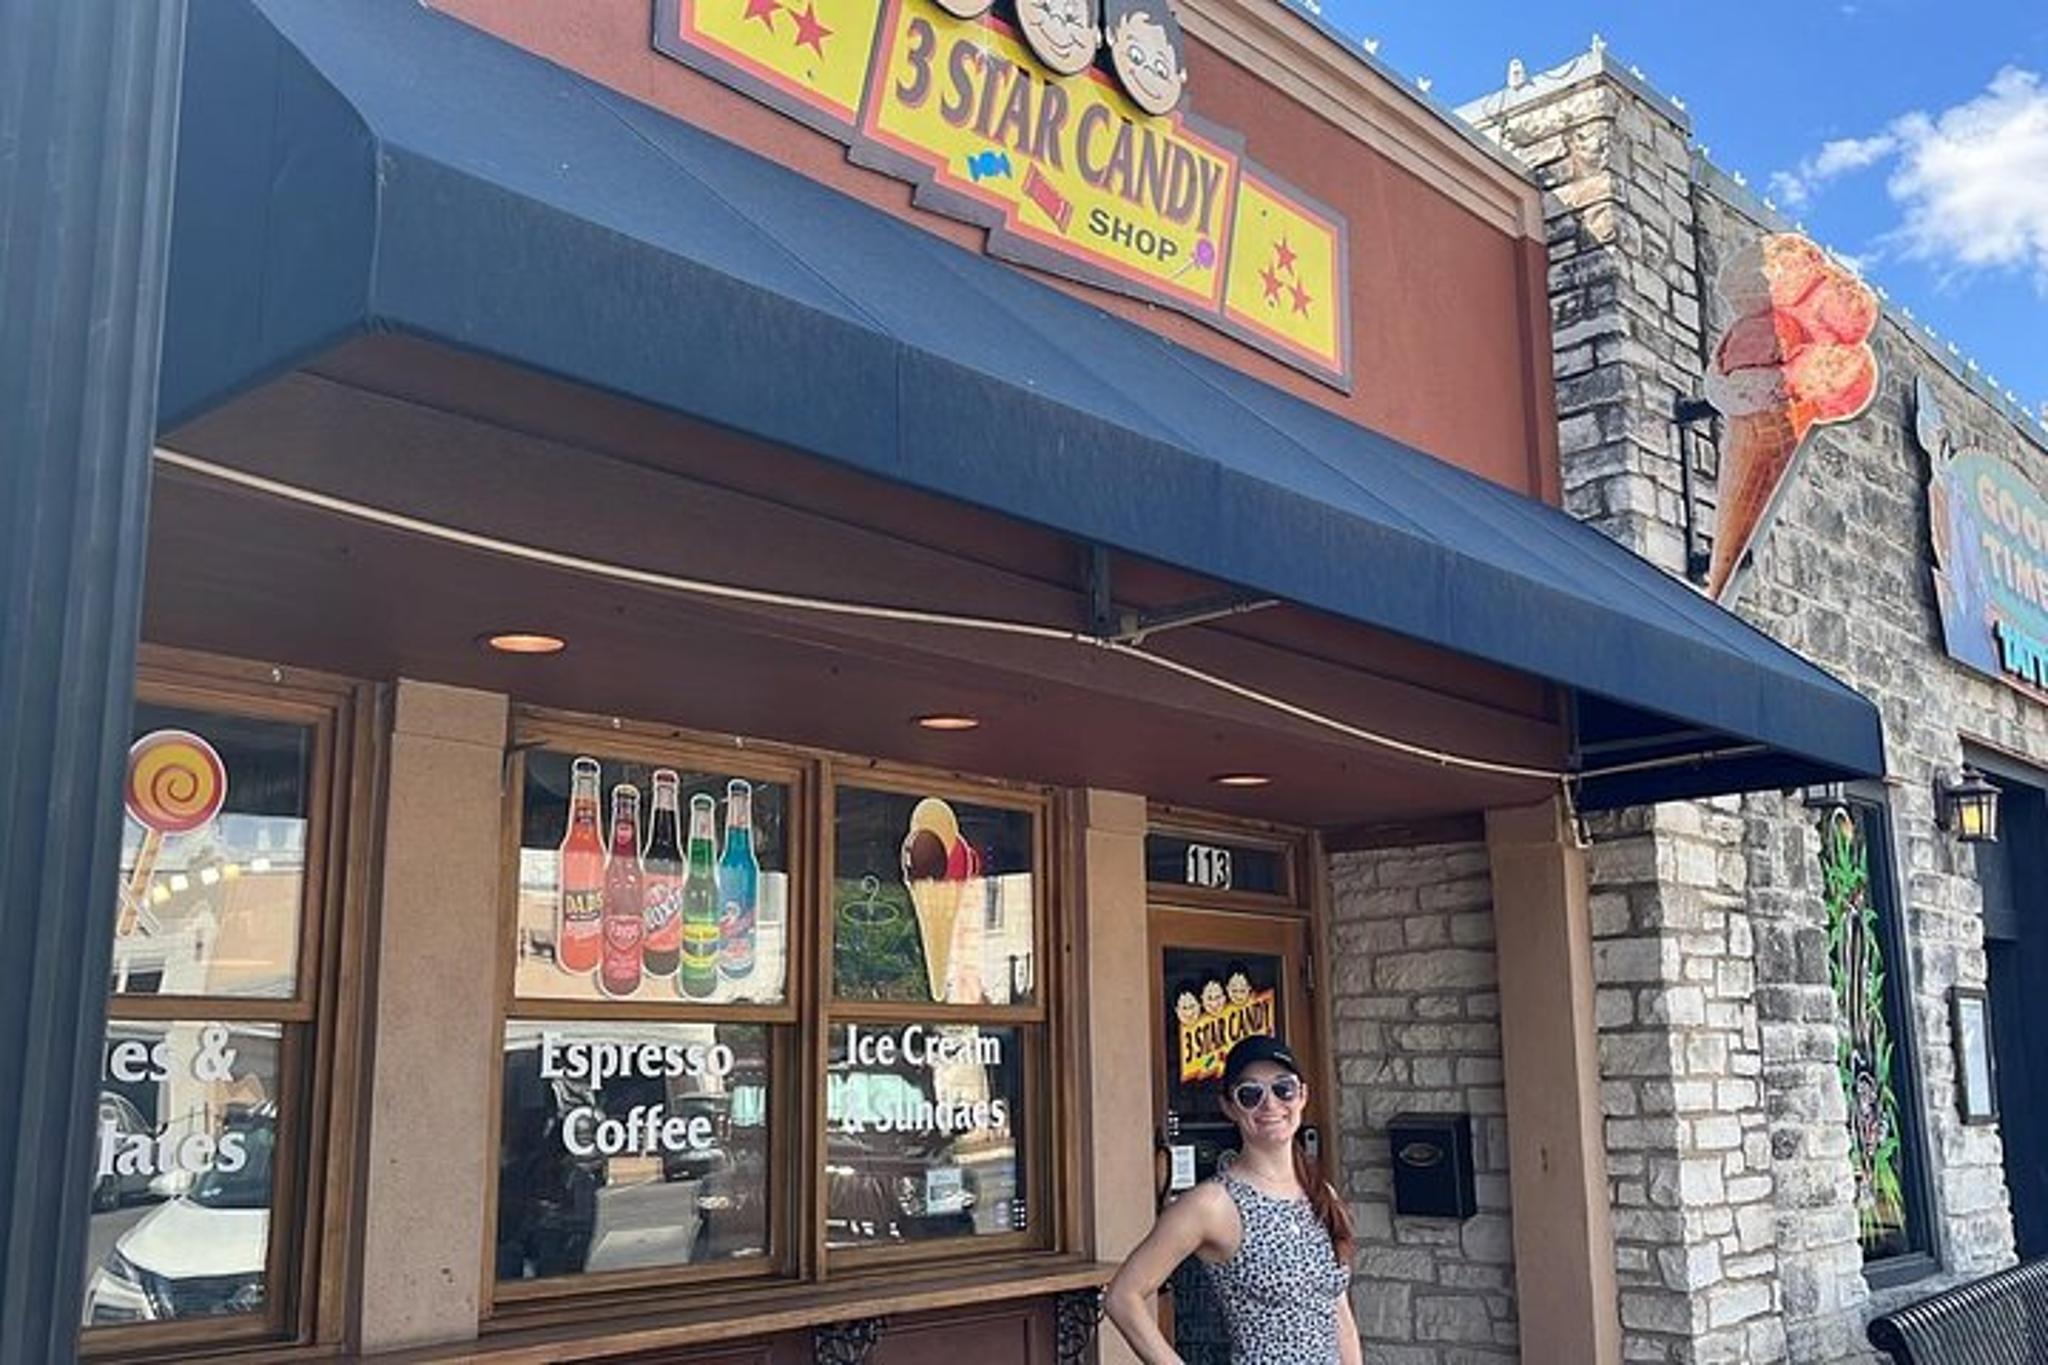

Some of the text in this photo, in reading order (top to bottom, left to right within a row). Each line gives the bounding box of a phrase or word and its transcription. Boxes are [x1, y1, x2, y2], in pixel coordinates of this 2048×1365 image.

[896, 17, 1223, 235] 3 STAR CANDY
[1088, 208, 1179, 263] SHOP
[1187, 844, 1231, 891] 113
[195, 1026, 238, 1083] &
[540, 1032, 734, 1090] Espresso
[847, 1024, 1001, 1065] Ice Cream
[1185, 1031, 1194, 1064] 3
[1195, 1016, 1228, 1059] STAR
[562, 1105, 713, 1156] Coffee
[874, 1091, 1006, 1134] Sundaes
